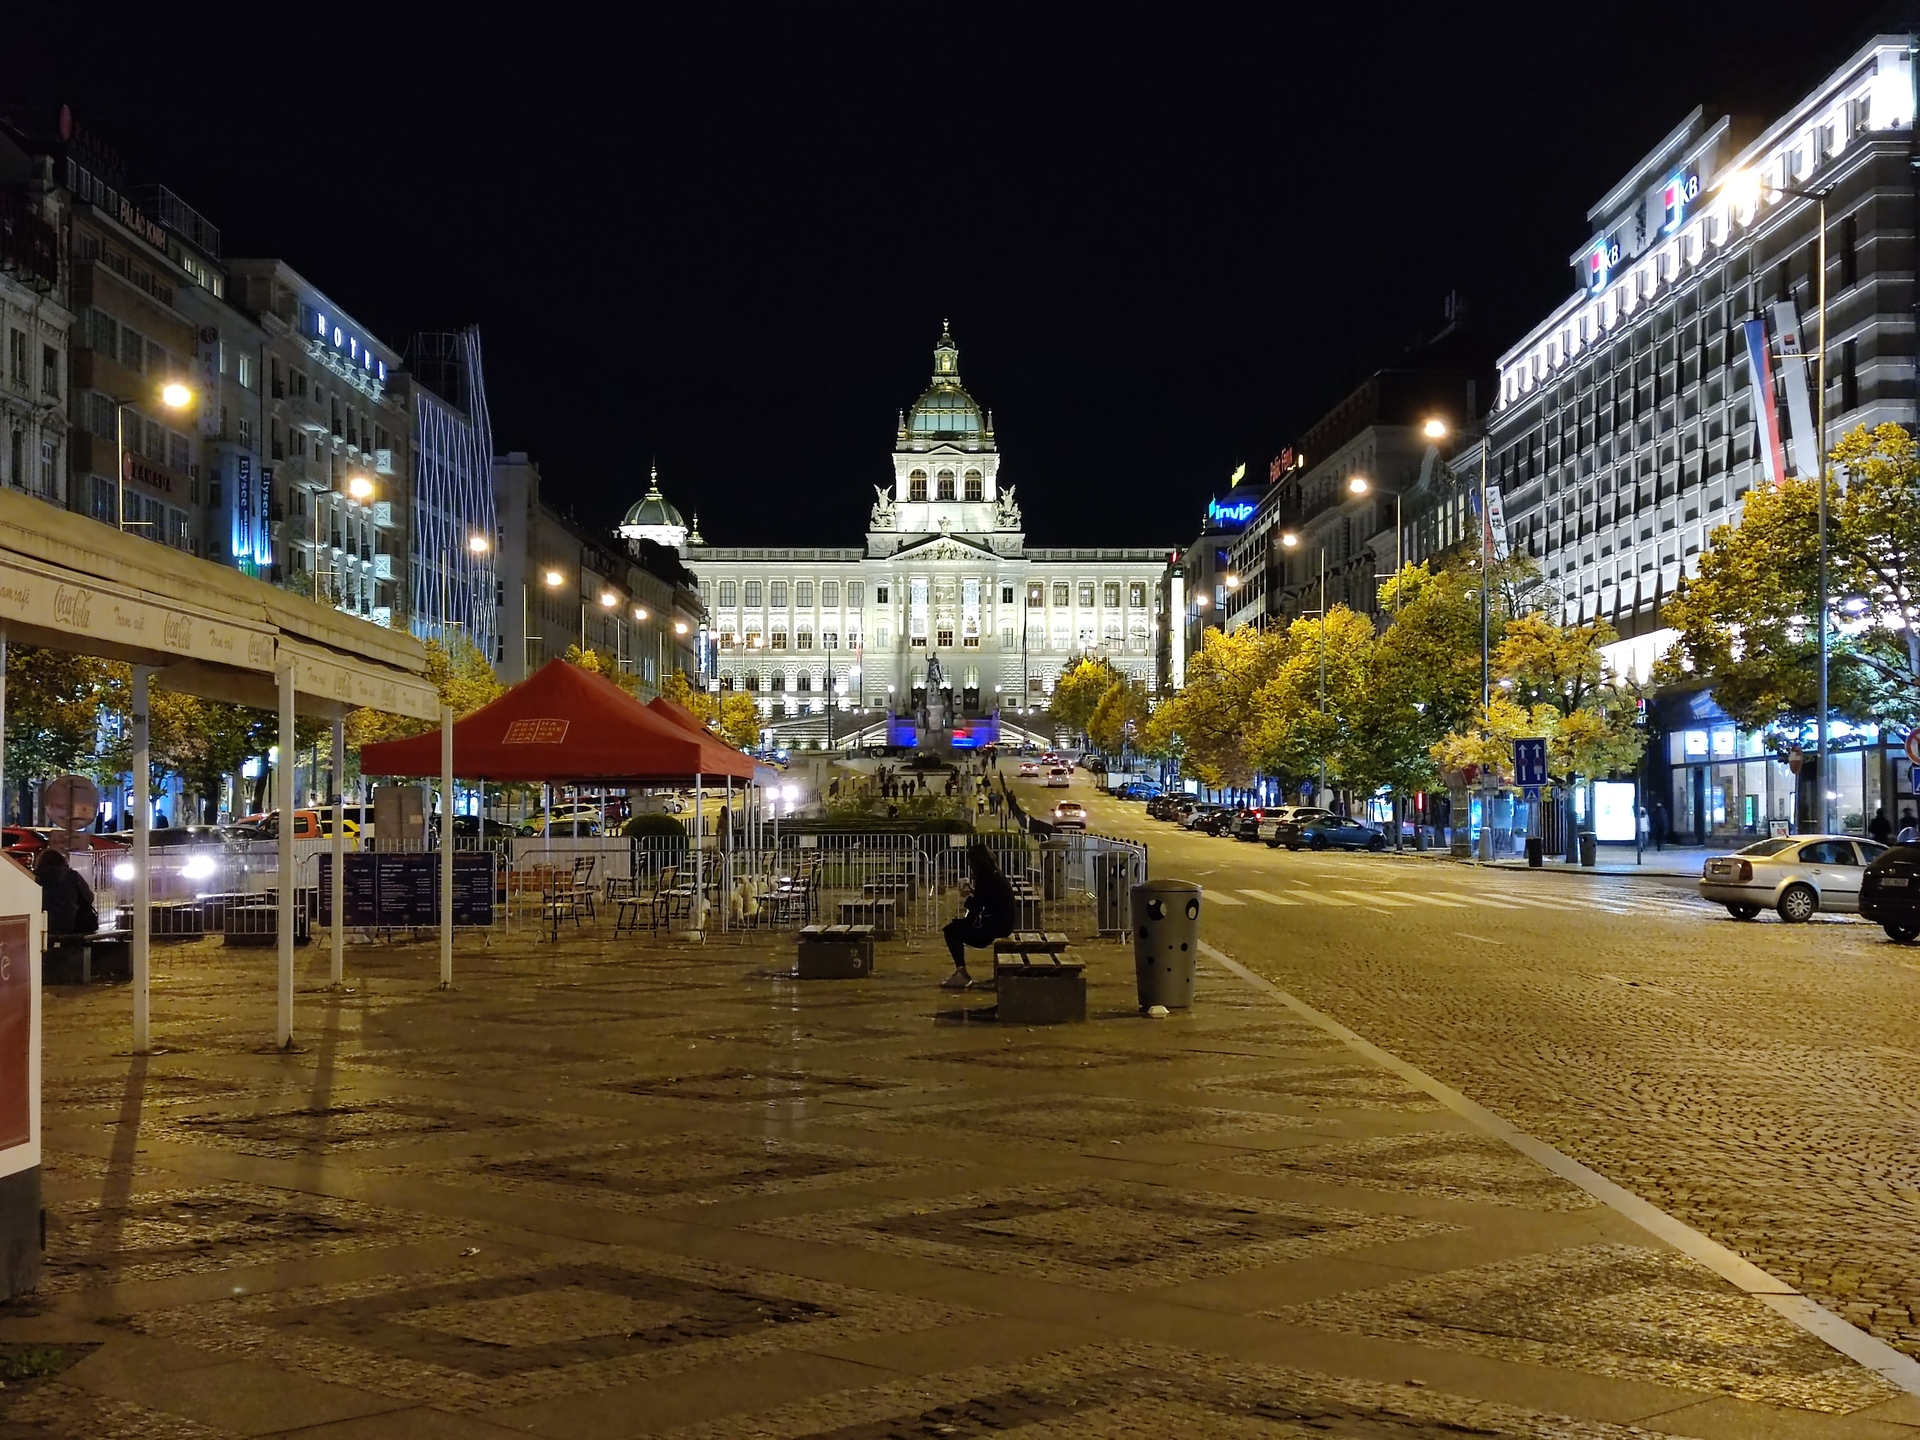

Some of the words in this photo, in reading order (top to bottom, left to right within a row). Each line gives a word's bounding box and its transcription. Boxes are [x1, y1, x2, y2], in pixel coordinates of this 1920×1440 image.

[1681, 175, 1699, 206] KB
[1605, 244, 1619, 270] KB
[317, 312, 385, 381] HOTEL
[203, 351, 214, 432] RAMADA
[240, 460, 249, 507] Elysee
[261, 472, 271, 517] Elysee
[1215, 503, 1253, 521] invia
[54, 584, 92, 629] Coca-Cola
[164, 612, 192, 650] Coca-Cola
